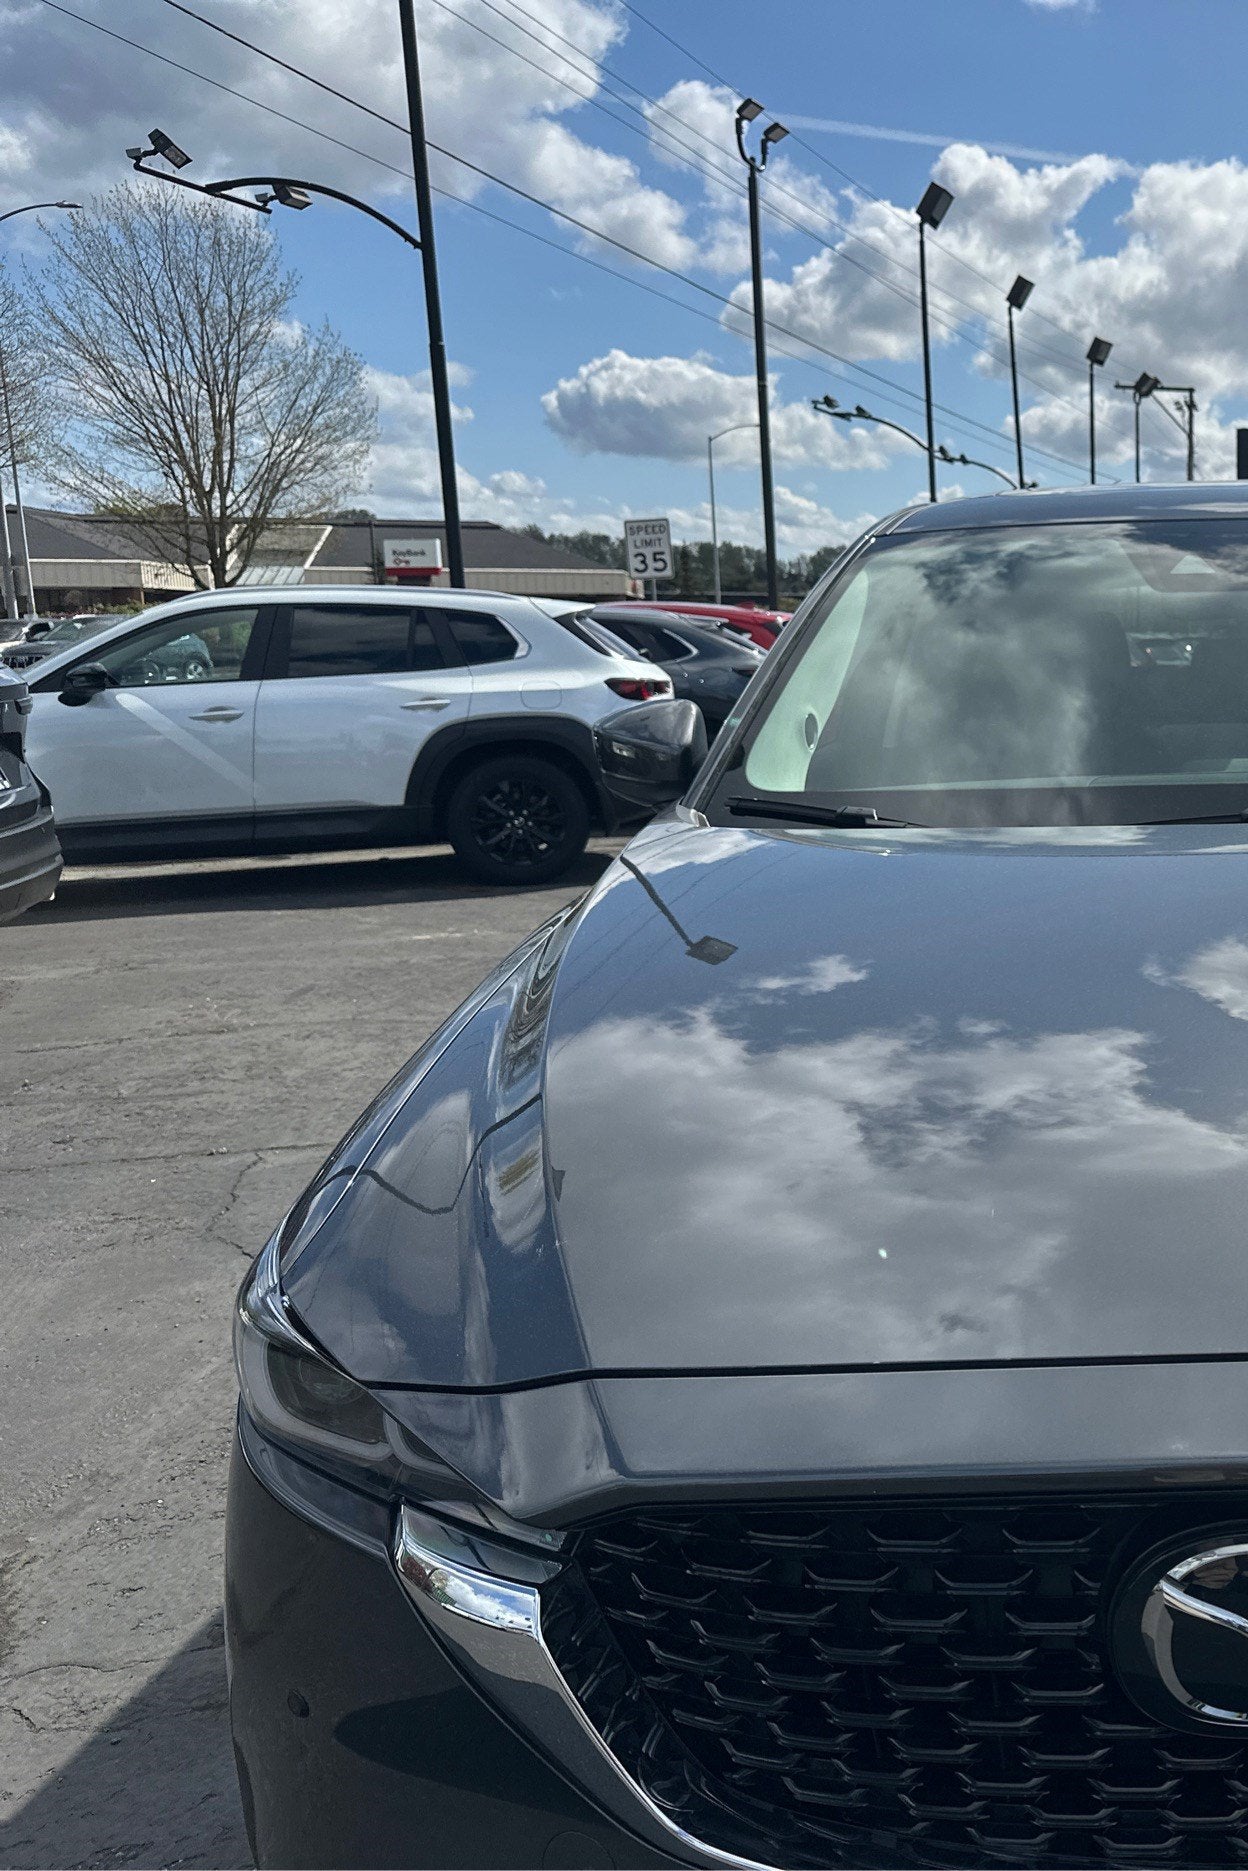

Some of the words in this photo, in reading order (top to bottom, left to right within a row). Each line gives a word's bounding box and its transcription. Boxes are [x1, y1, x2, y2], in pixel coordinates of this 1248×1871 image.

[629, 524, 666, 535] SPEED
[634, 538, 662, 549] LIMIT
[634, 552, 667, 572] 35
